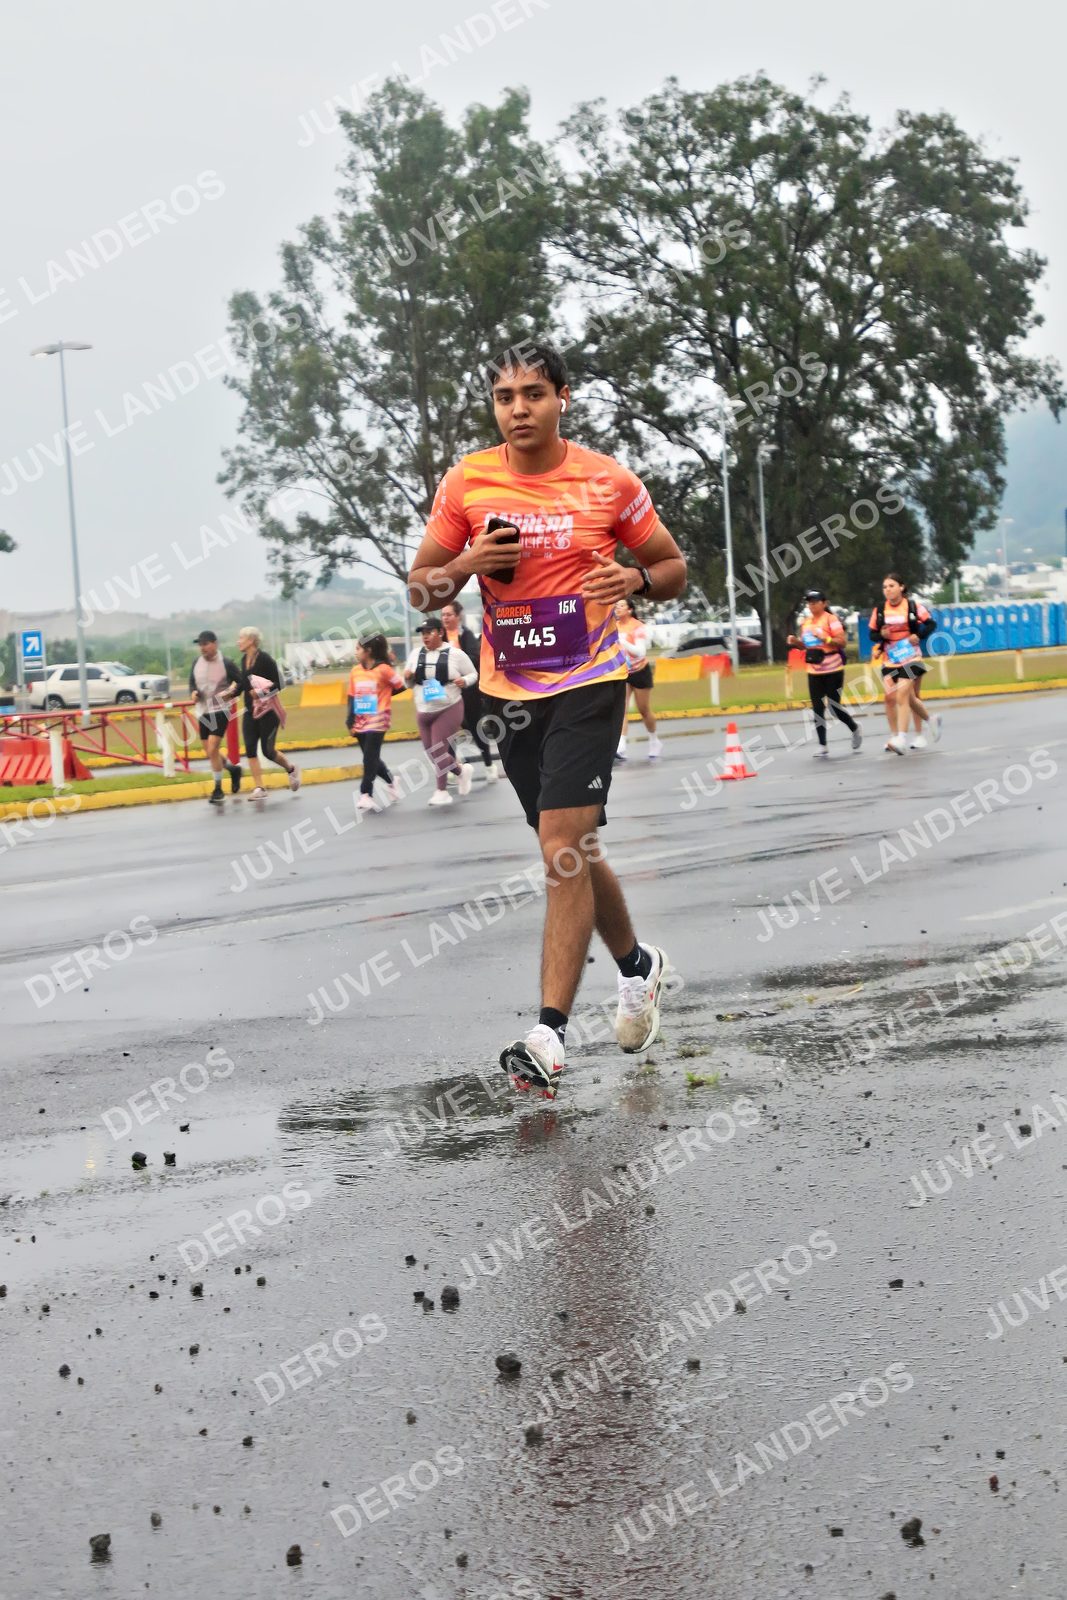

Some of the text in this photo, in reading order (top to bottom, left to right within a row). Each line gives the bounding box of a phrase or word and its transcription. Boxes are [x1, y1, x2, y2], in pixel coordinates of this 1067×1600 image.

[519, 535, 552, 549] ILIFE
[496, 605, 532, 618] CARRERA
[513, 626, 557, 649] 445
